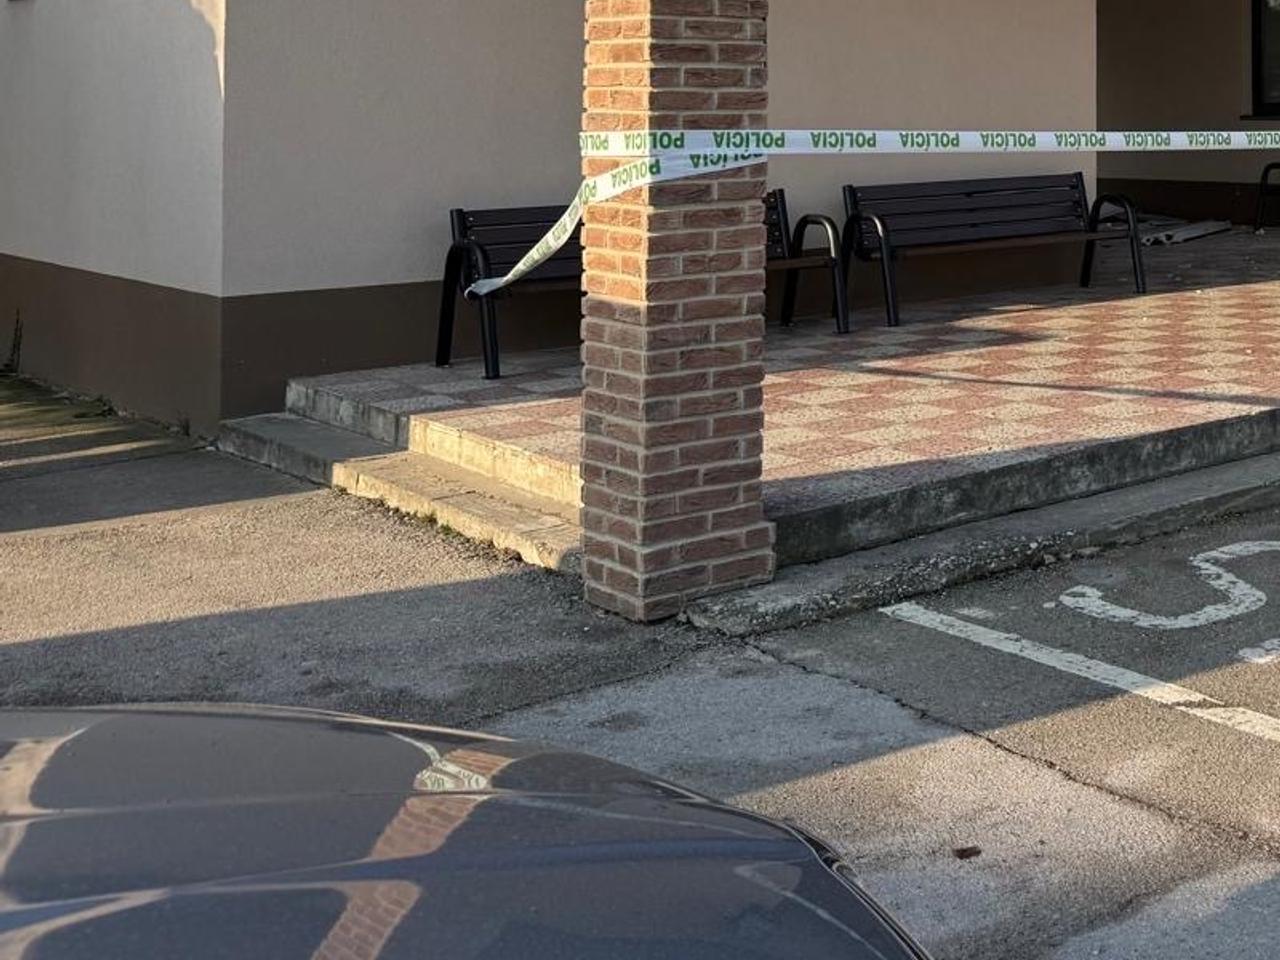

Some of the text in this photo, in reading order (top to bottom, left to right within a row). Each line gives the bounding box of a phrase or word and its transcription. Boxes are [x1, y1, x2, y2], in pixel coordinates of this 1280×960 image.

[623, 132, 685, 153] POLÍCIA
[712, 131, 785, 154] POLÍCIA
[810, 132, 877, 151] POLÍCIA
[899, 132, 960, 151] POLÍCIA
[979, 132, 1036, 151] POLÍCIA
[1054, 132, 1106, 150] POLÍCIA
[1123, 132, 1171, 150] POLÍCIA
[1185, 133, 1232, 148] POLÍCIA
[611, 157, 661, 189] POLÍCIA
